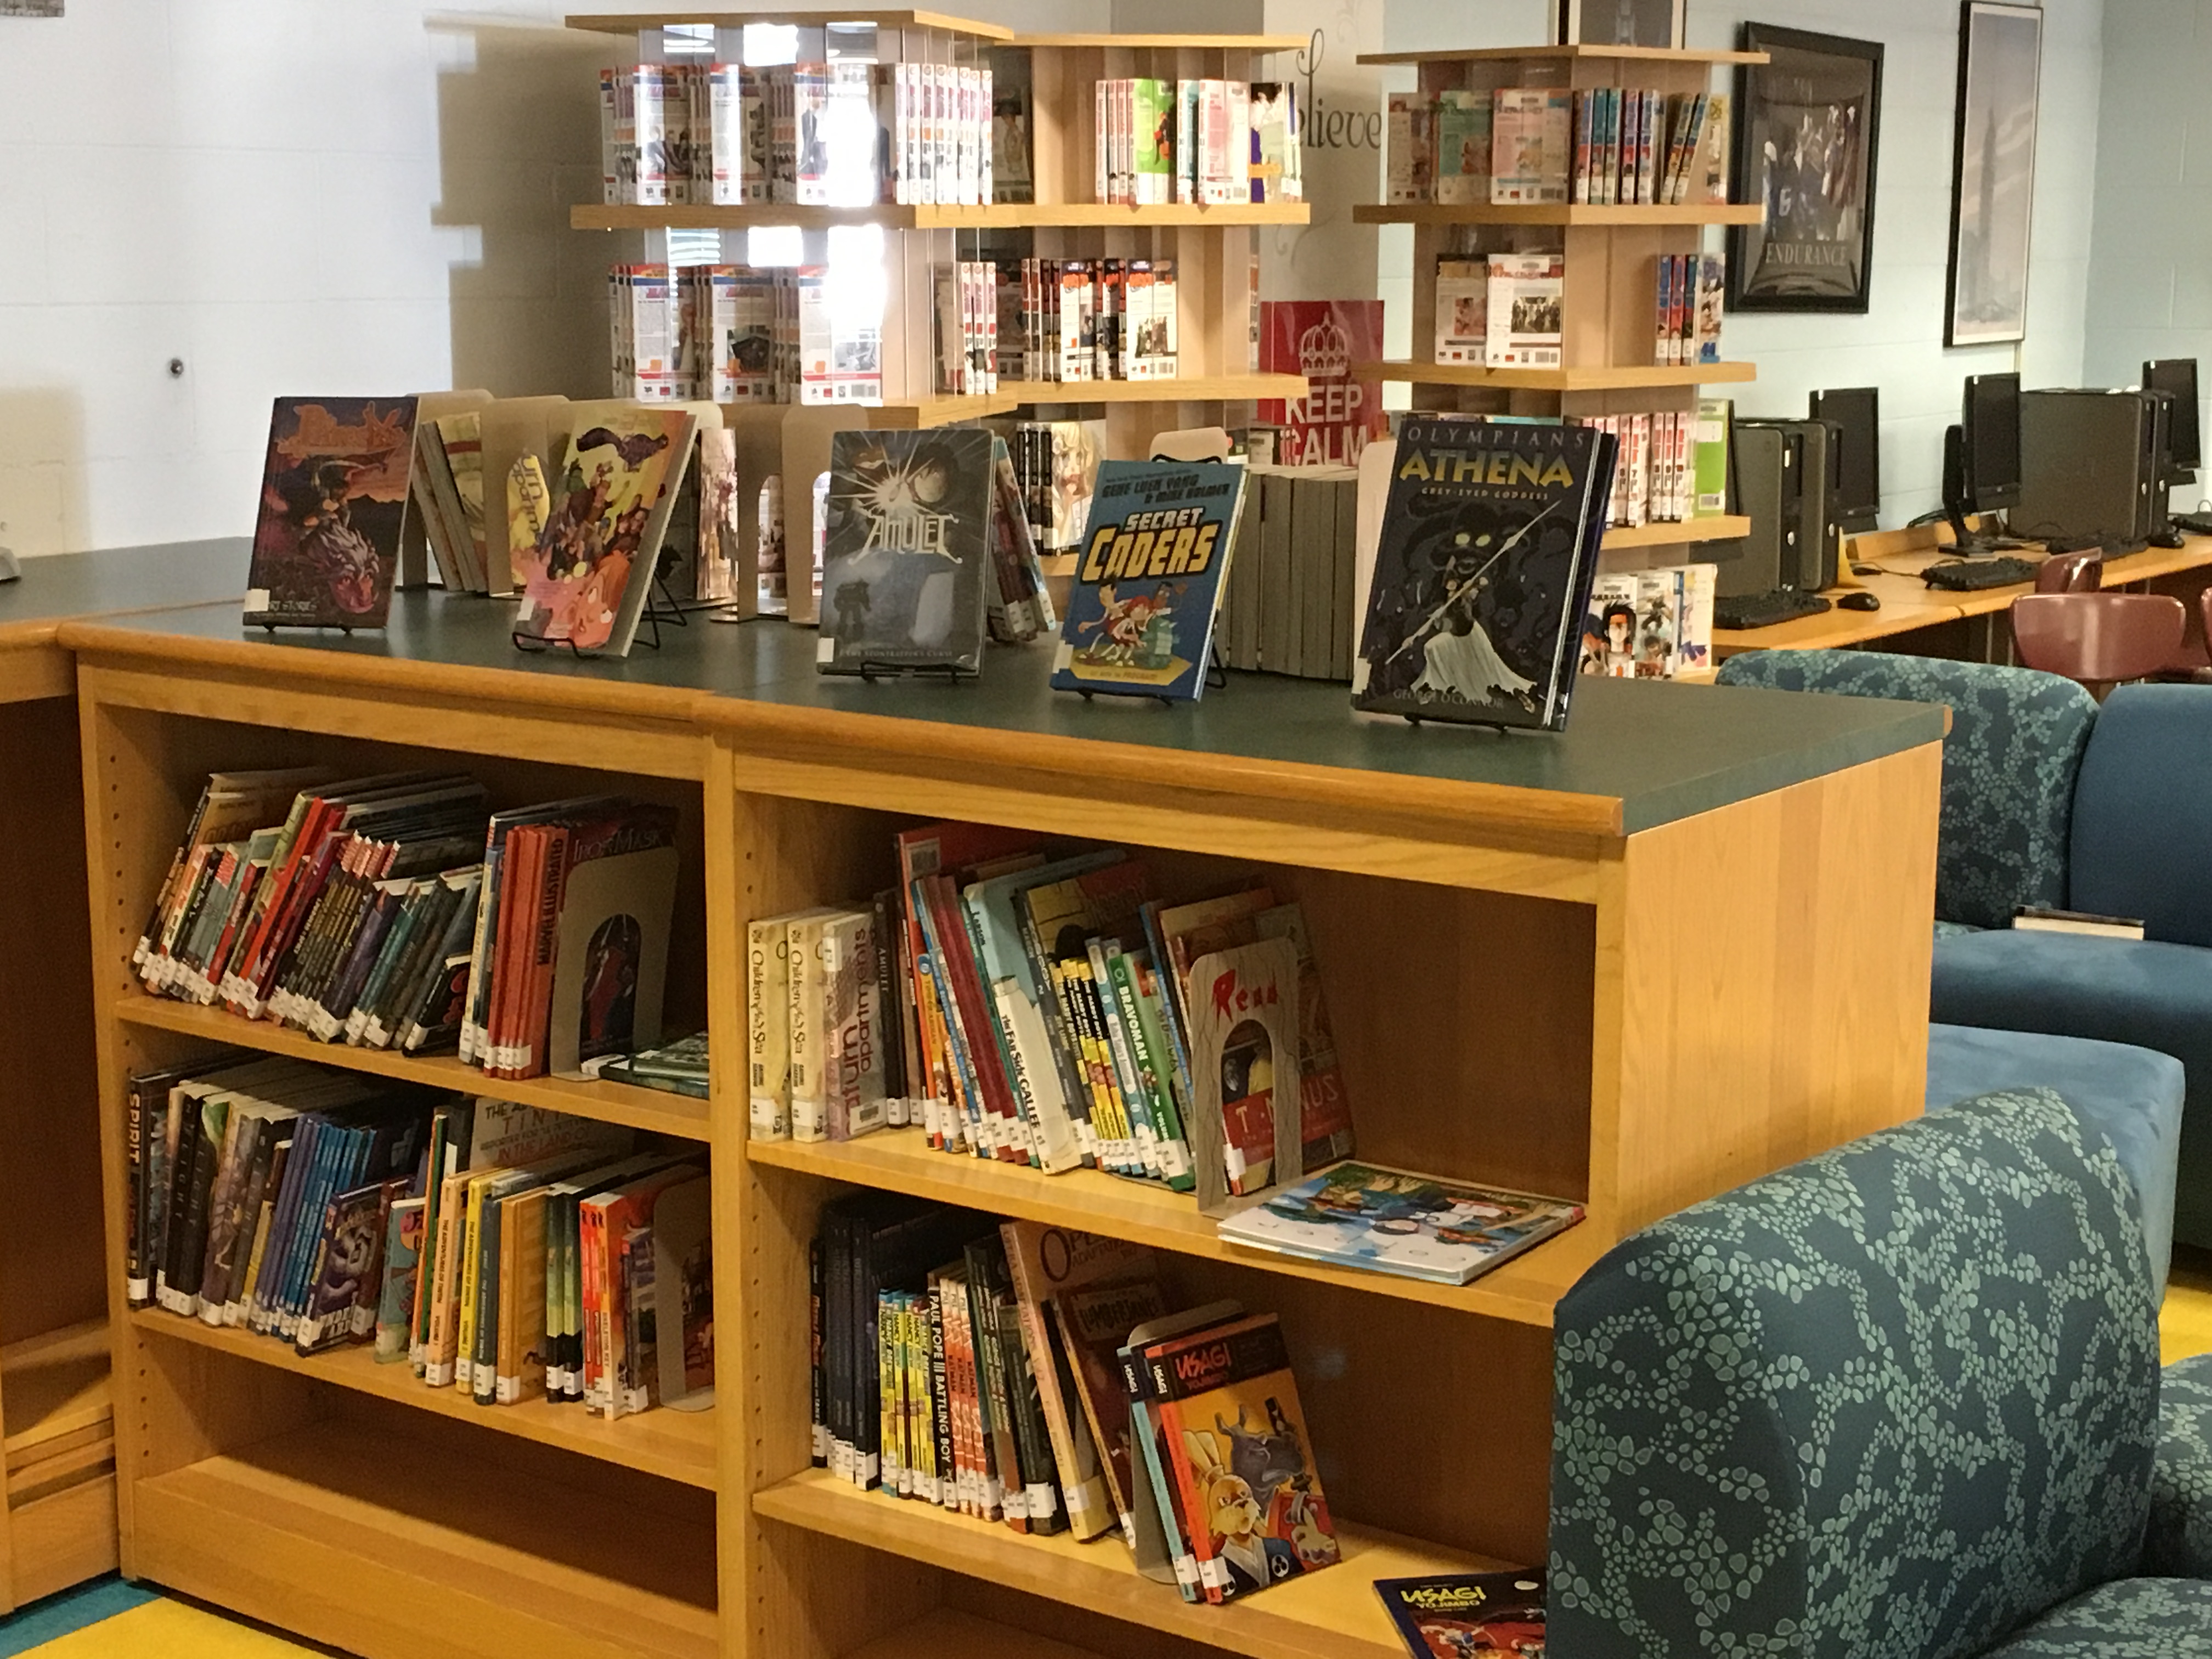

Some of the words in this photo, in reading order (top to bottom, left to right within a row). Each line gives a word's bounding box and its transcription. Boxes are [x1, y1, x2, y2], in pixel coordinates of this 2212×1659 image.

[1765, 242, 1848, 267] ENDURANCE
[1285, 383, 1363, 425] KEEP
[1280, 424, 1368, 466] CALM
[1408, 426, 1584, 448] OLYMPIANS
[1400, 448, 1574, 488] ATHENA
[1125, 507, 1205, 532] SECRET
[848, 512, 963, 565] AMULET
[1081, 523, 1219, 582] CODERS
[543, 838, 564, 918] ILLUSTRATED
[971, 911, 986, 946] LARSON
[878, 947, 889, 992] AMULET
[854, 928, 873, 1073] apartments
[1212, 969, 1278, 1032] Read
[1119, 986, 1149, 1061] BRAVOMAN
[752, 1029, 766, 1054] Sea
[793, 1029, 806, 1054] Sea
[129, 1092, 140, 1164] SPIRIT
[486, 1102, 507, 1120] THE
[929, 1295, 941, 1324] PAUL
[932, 1327, 944, 1359] POPE
[1124, 1364, 1138, 1393] USAGI
[1175, 1342, 1232, 1380] USAGI
[1153, 1364, 1168, 1394] USAGI
[936, 1375, 949, 1435] BATTLING
[940, 1437, 951, 1463] BOY
[1400, 1585, 1487, 1604] USAGI
[1415, 1600, 1480, 1609] YOJIMBO
